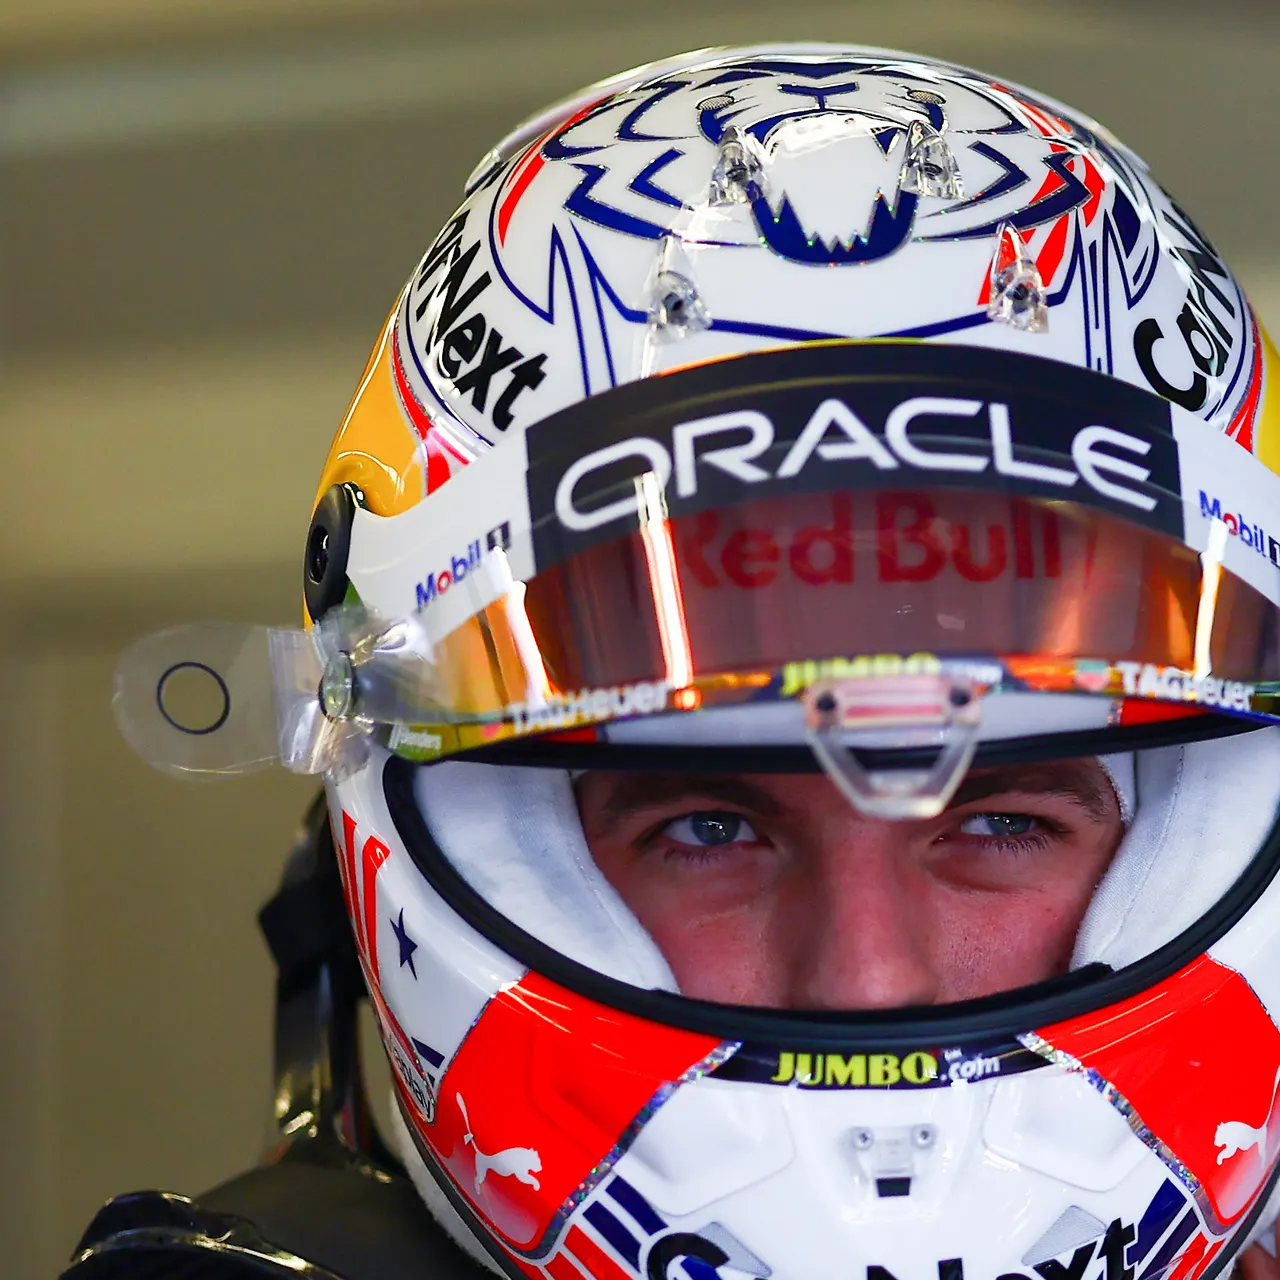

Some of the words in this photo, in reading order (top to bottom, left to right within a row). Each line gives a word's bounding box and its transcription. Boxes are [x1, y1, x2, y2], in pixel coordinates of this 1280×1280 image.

[555, 397, 1158, 531] ORACLE
[876, 488, 1062, 584] Bull
[1199, 489, 1267, 558] Mobil
[416, 539, 481, 613] Mobil
